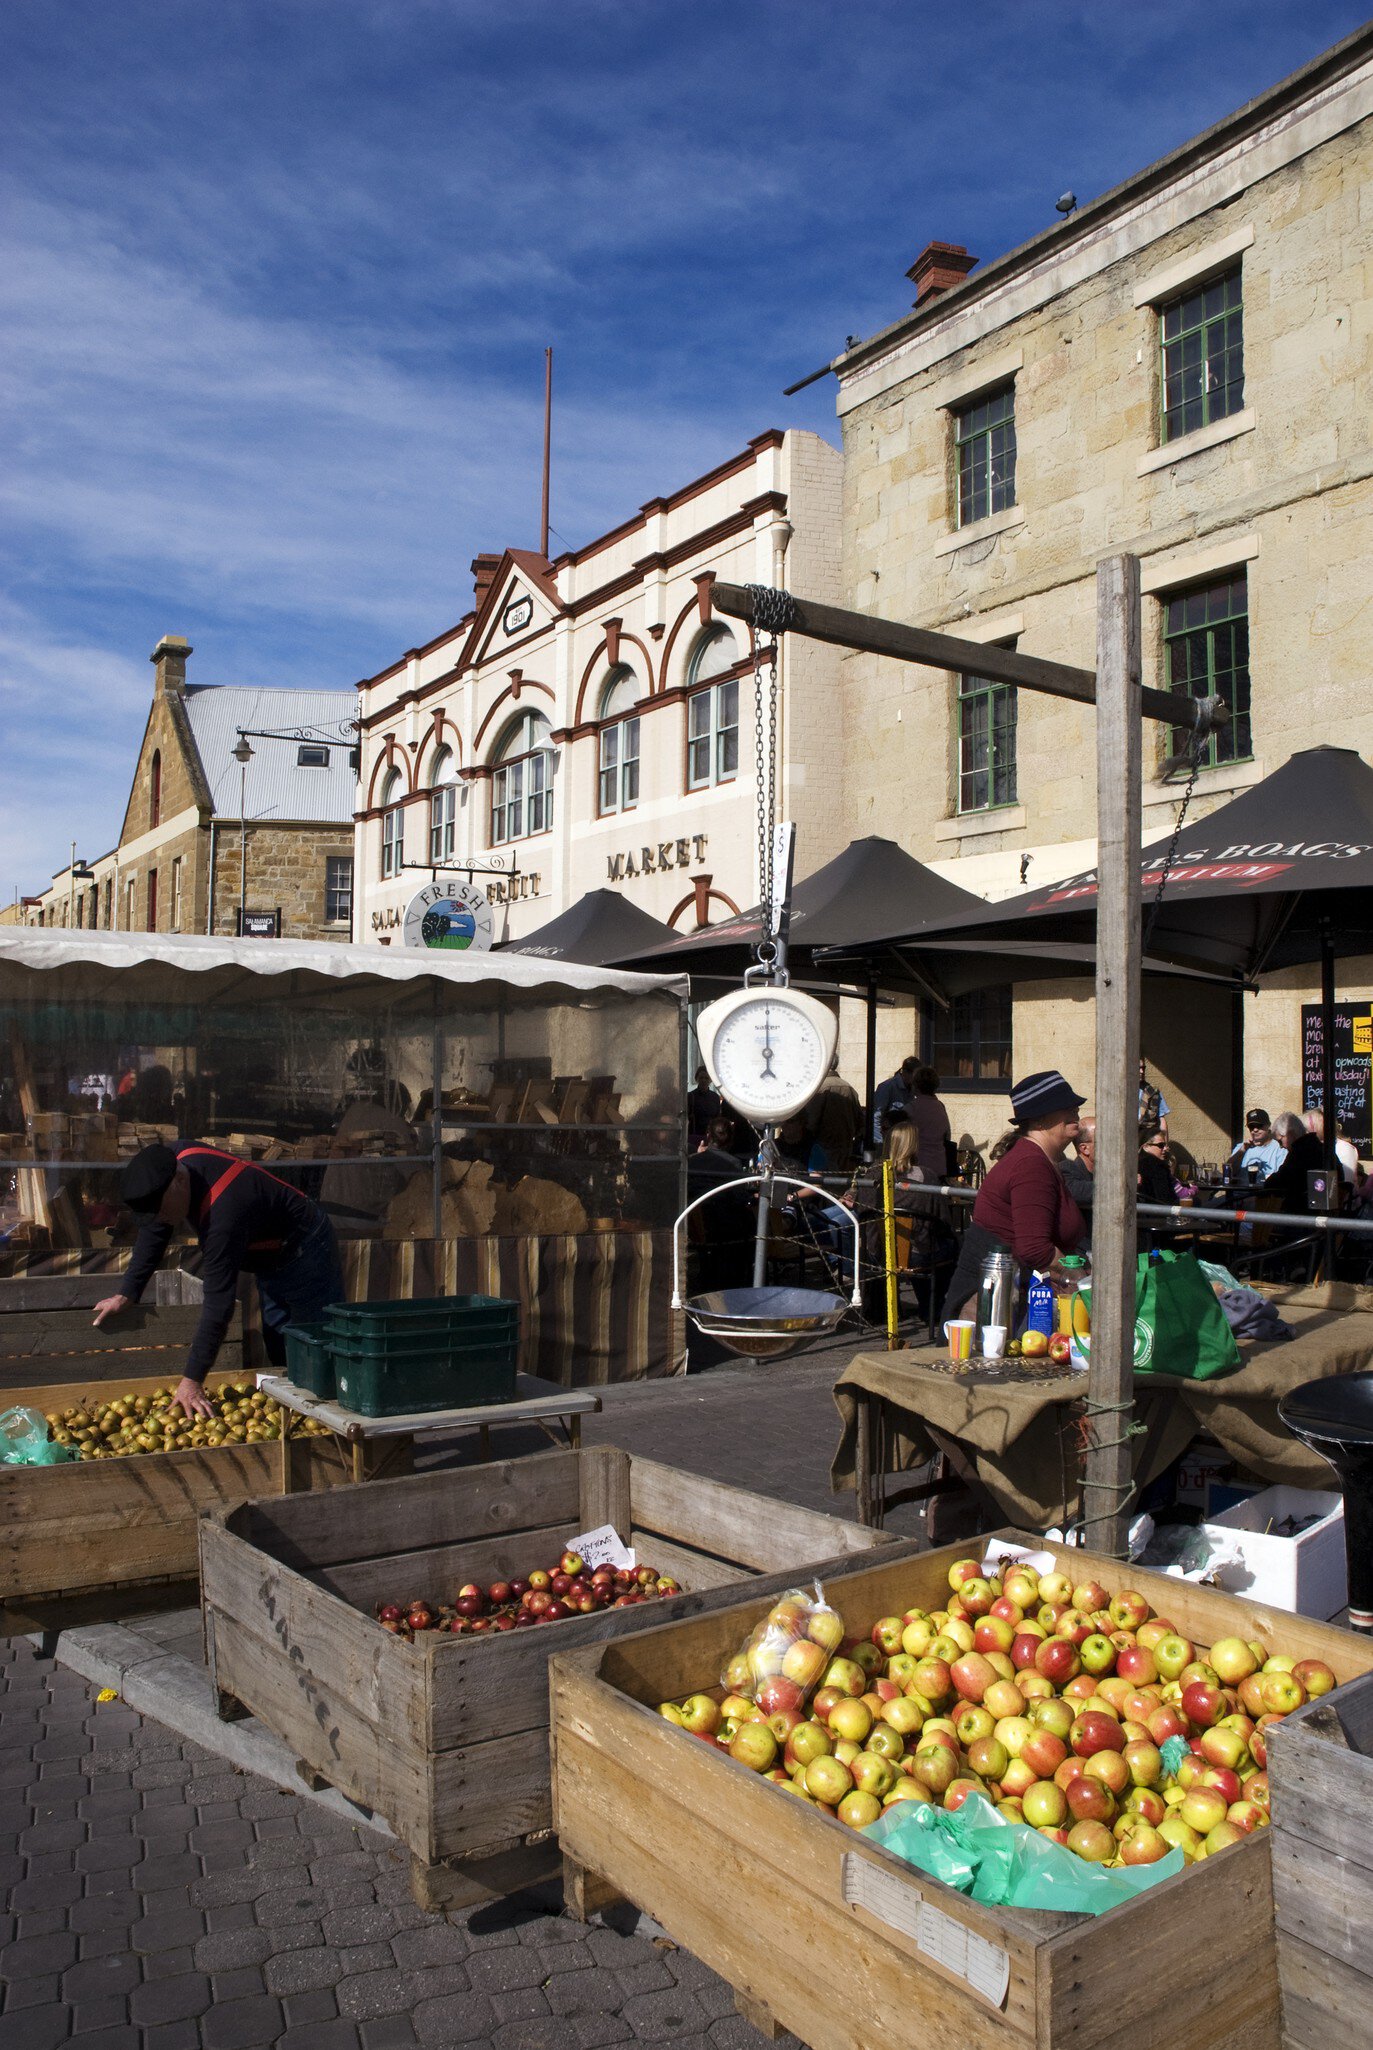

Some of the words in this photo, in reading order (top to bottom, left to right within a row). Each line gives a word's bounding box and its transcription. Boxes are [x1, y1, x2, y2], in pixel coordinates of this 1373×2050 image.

[606, 834, 708, 882] MARKET
[1048, 848, 1209, 892] JAES
[1212, 841, 1373, 861] BOAG'S
[420, 883, 485, 911] FRESH
[486, 872, 542, 906] FRUIT
[1334, 1014, 1351, 1028] the
[1306, 1057, 1319, 1068] at
